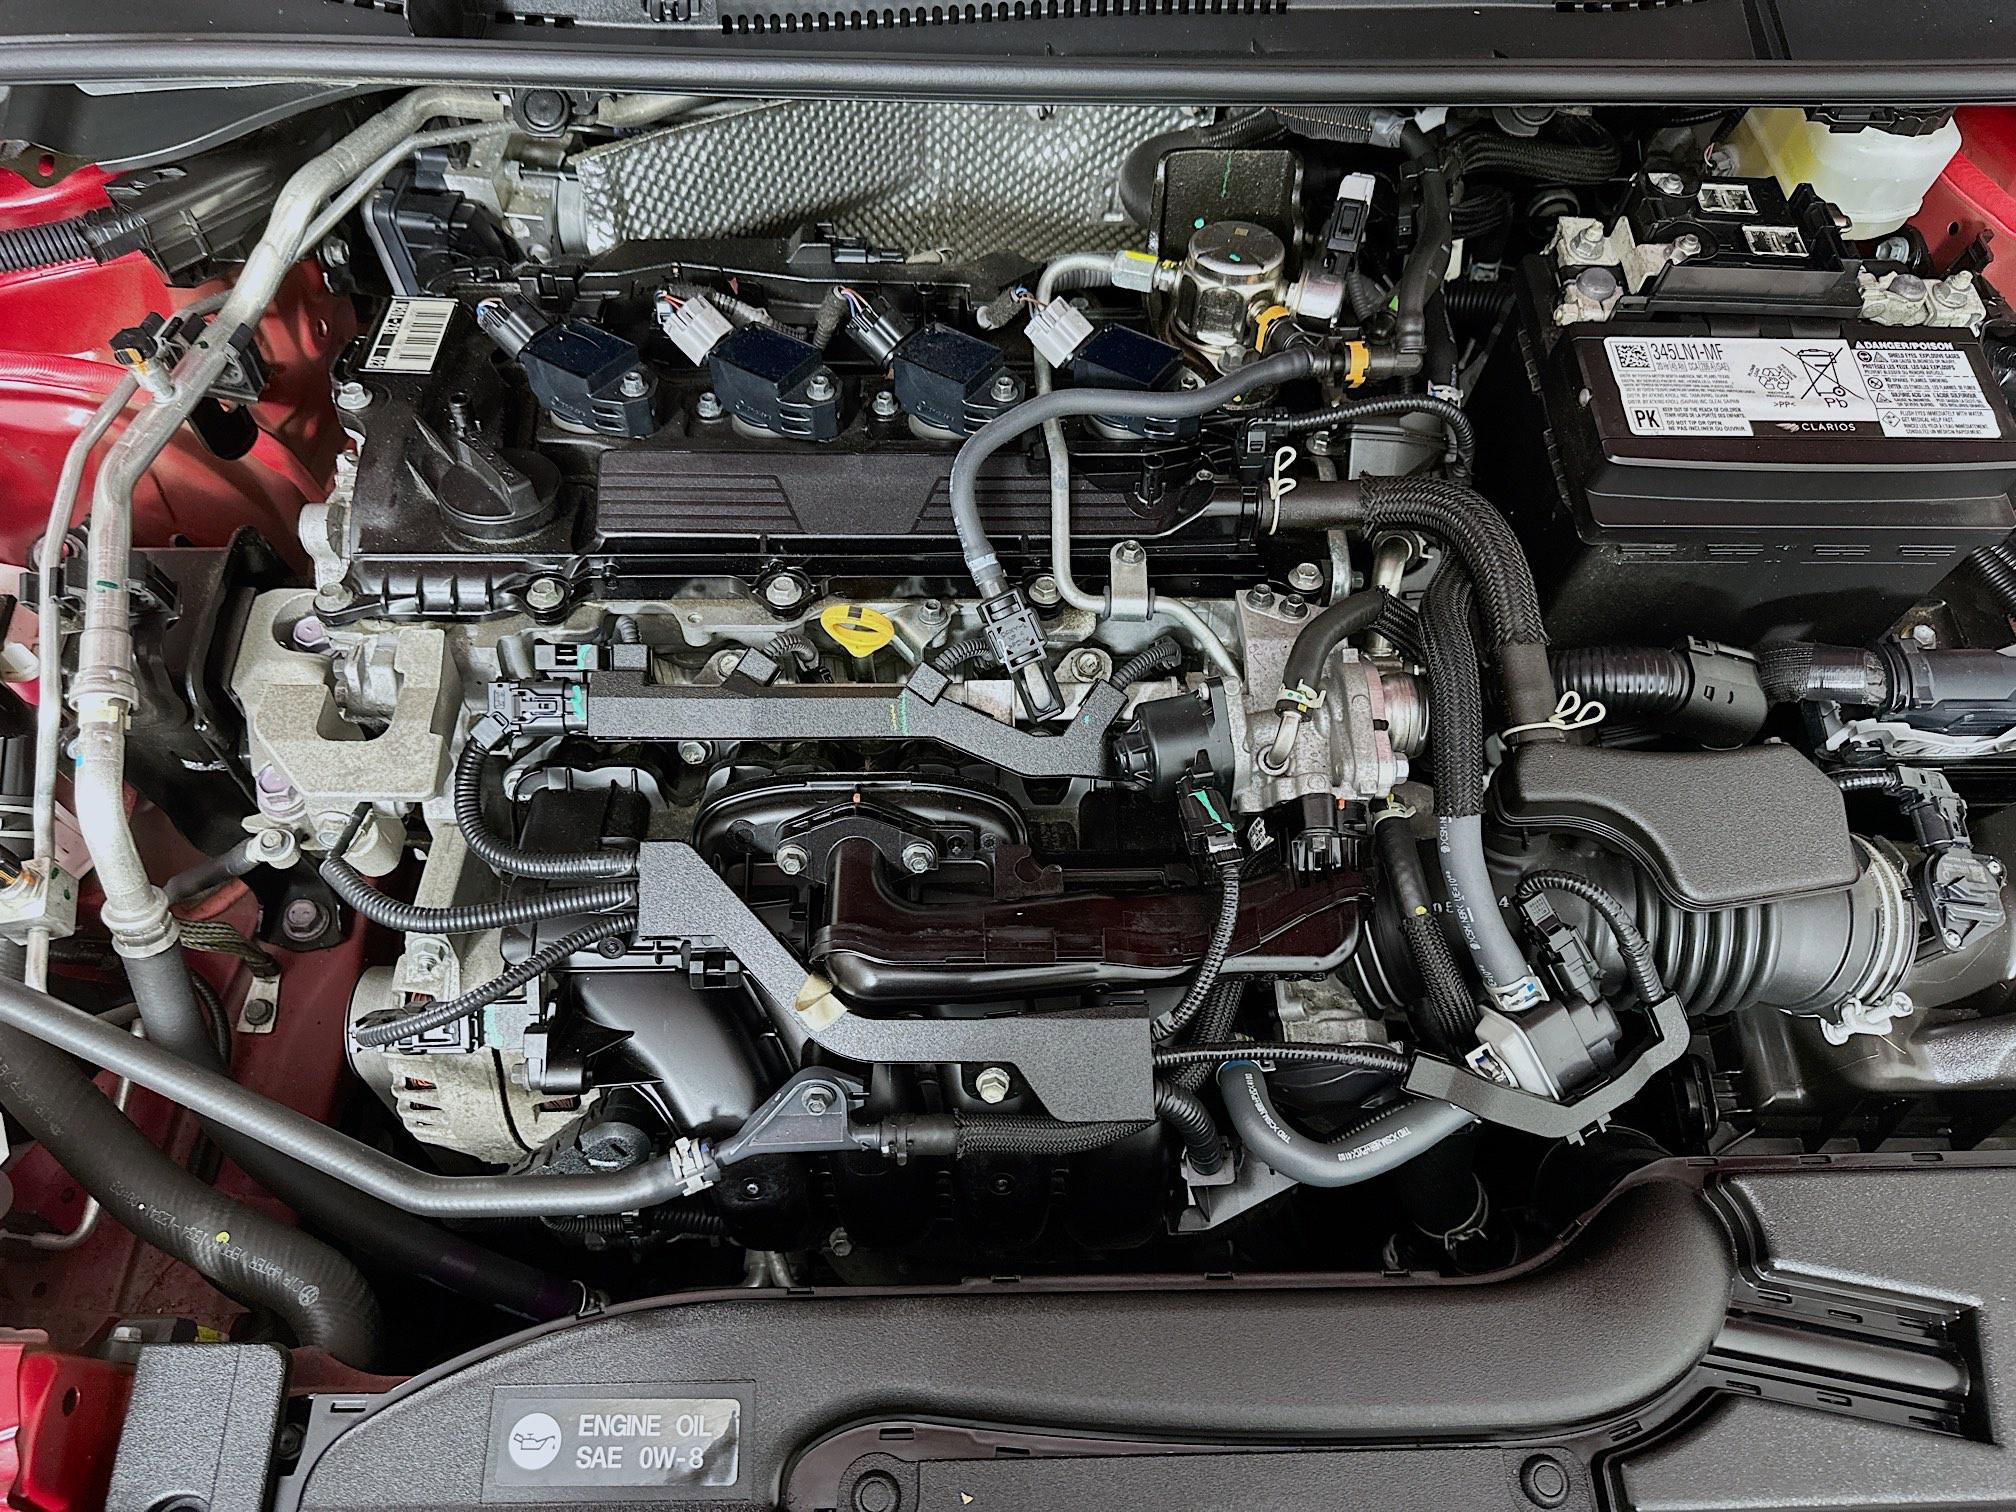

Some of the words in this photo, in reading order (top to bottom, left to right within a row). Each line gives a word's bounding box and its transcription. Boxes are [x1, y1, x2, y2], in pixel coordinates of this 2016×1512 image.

[1651, 343, 1723, 360] 345LN1-MF
[1864, 341, 1954, 350] DANGER/POISON
[1824, 398, 1848, 408] Pb
[1635, 410, 1660, 427] PK
[1801, 423, 1856, 431] CLARIOS
[578, 1414, 662, 1437] ENGINE
[676, 1414, 712, 1437] OIL
[575, 1446, 624, 1469] SAE
[639, 1446, 704, 1469] 0W-8
